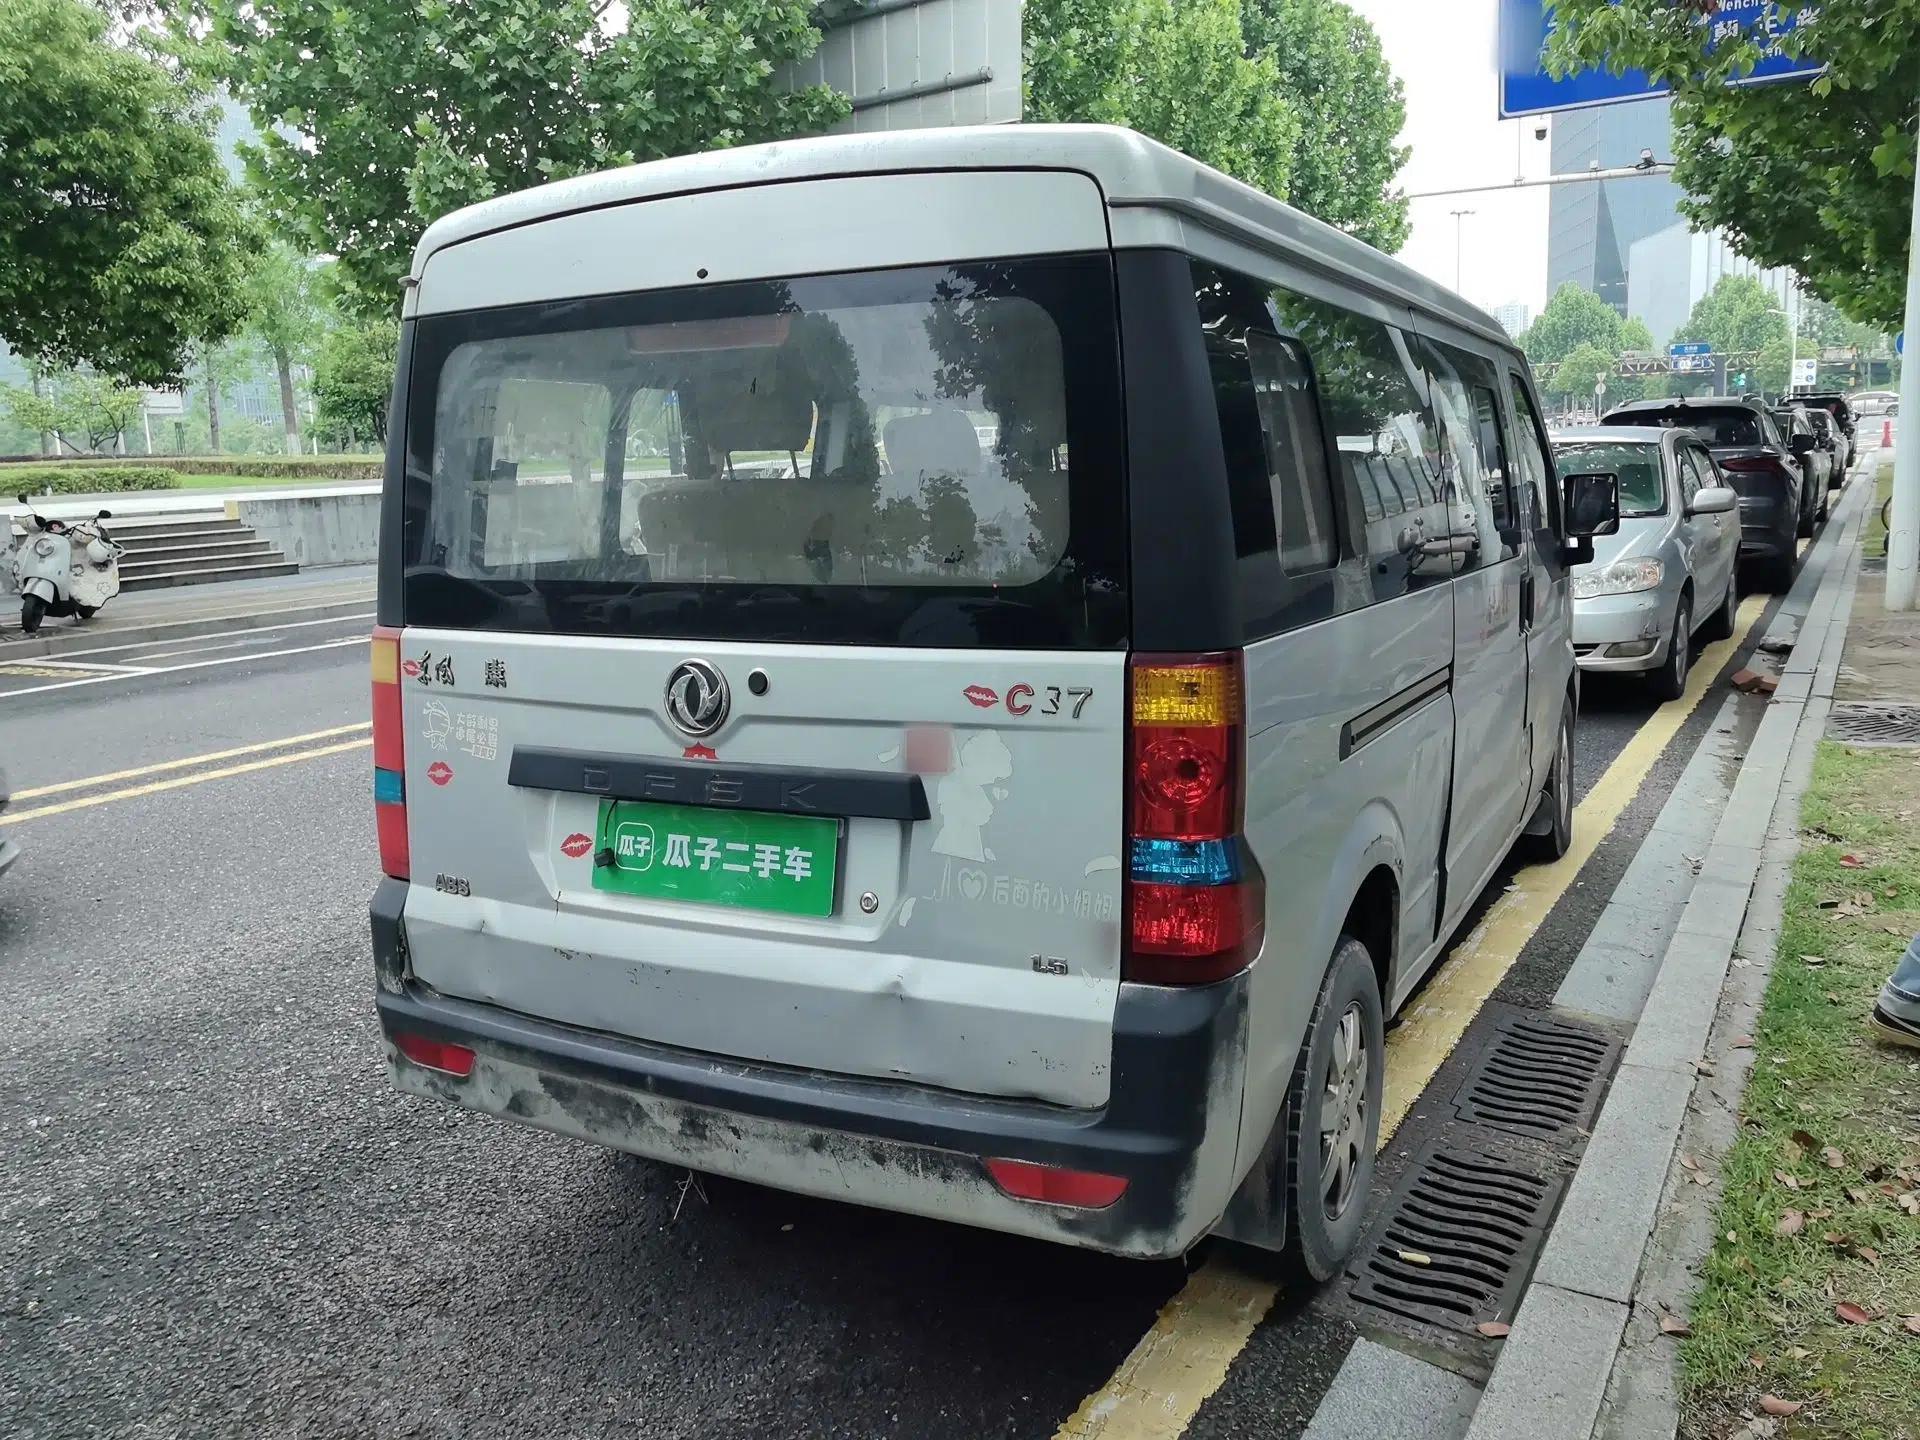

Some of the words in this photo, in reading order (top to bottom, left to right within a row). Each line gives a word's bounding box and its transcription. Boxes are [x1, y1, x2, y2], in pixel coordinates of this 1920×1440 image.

[1005, 683, 1093, 719] C37
[583, 765, 817, 809] DFSK
[618, 834, 651, 857] 瓜子
[662, 833, 813, 882] 瓜子二手车
[435, 872, 472, 897] ABS
